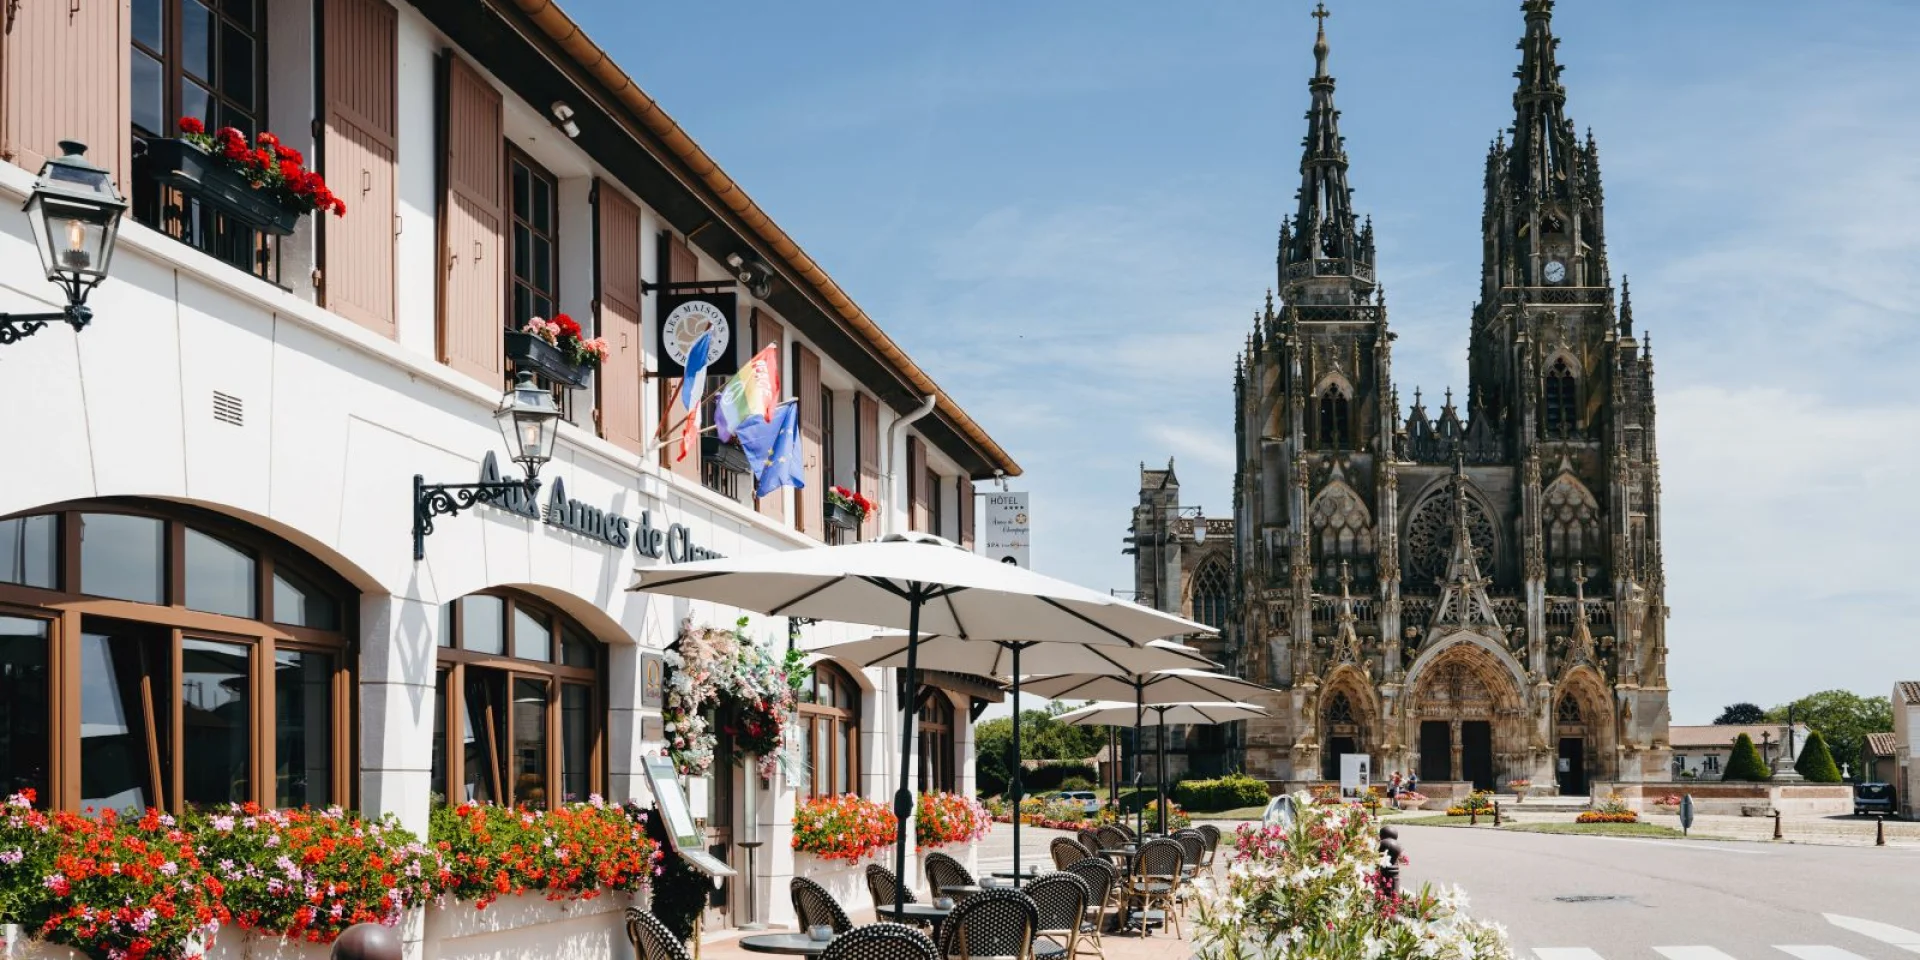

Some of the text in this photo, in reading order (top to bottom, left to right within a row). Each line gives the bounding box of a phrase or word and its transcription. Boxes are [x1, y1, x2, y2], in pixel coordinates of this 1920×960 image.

[666, 304, 725, 334] LES MAISONS
[478, 449, 541, 521] Aux
[542, 475, 631, 550] Armes
[635, 510, 664, 560] de
[990, 495, 1018, 505] HÔTEL
